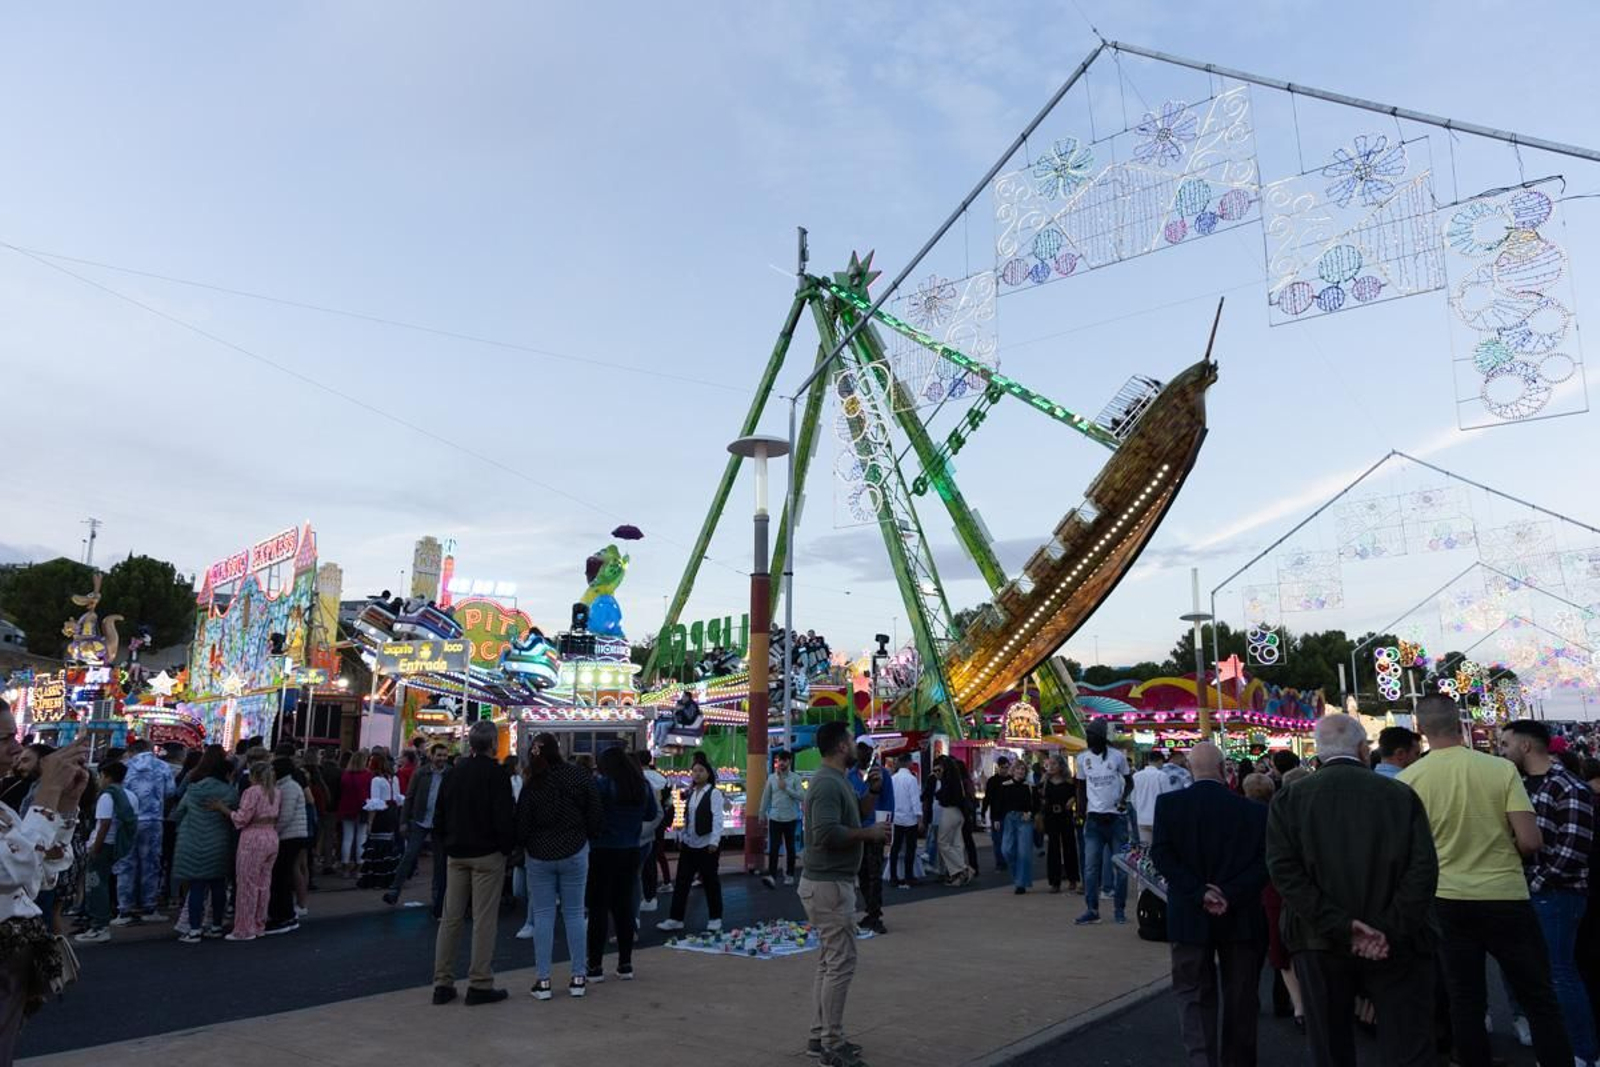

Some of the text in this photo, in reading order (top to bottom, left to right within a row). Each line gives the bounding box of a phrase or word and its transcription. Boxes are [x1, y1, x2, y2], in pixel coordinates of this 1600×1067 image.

[465, 608, 530, 642] PIT
[444, 641, 463, 653] loco
[398, 658, 448, 672] Entrada
